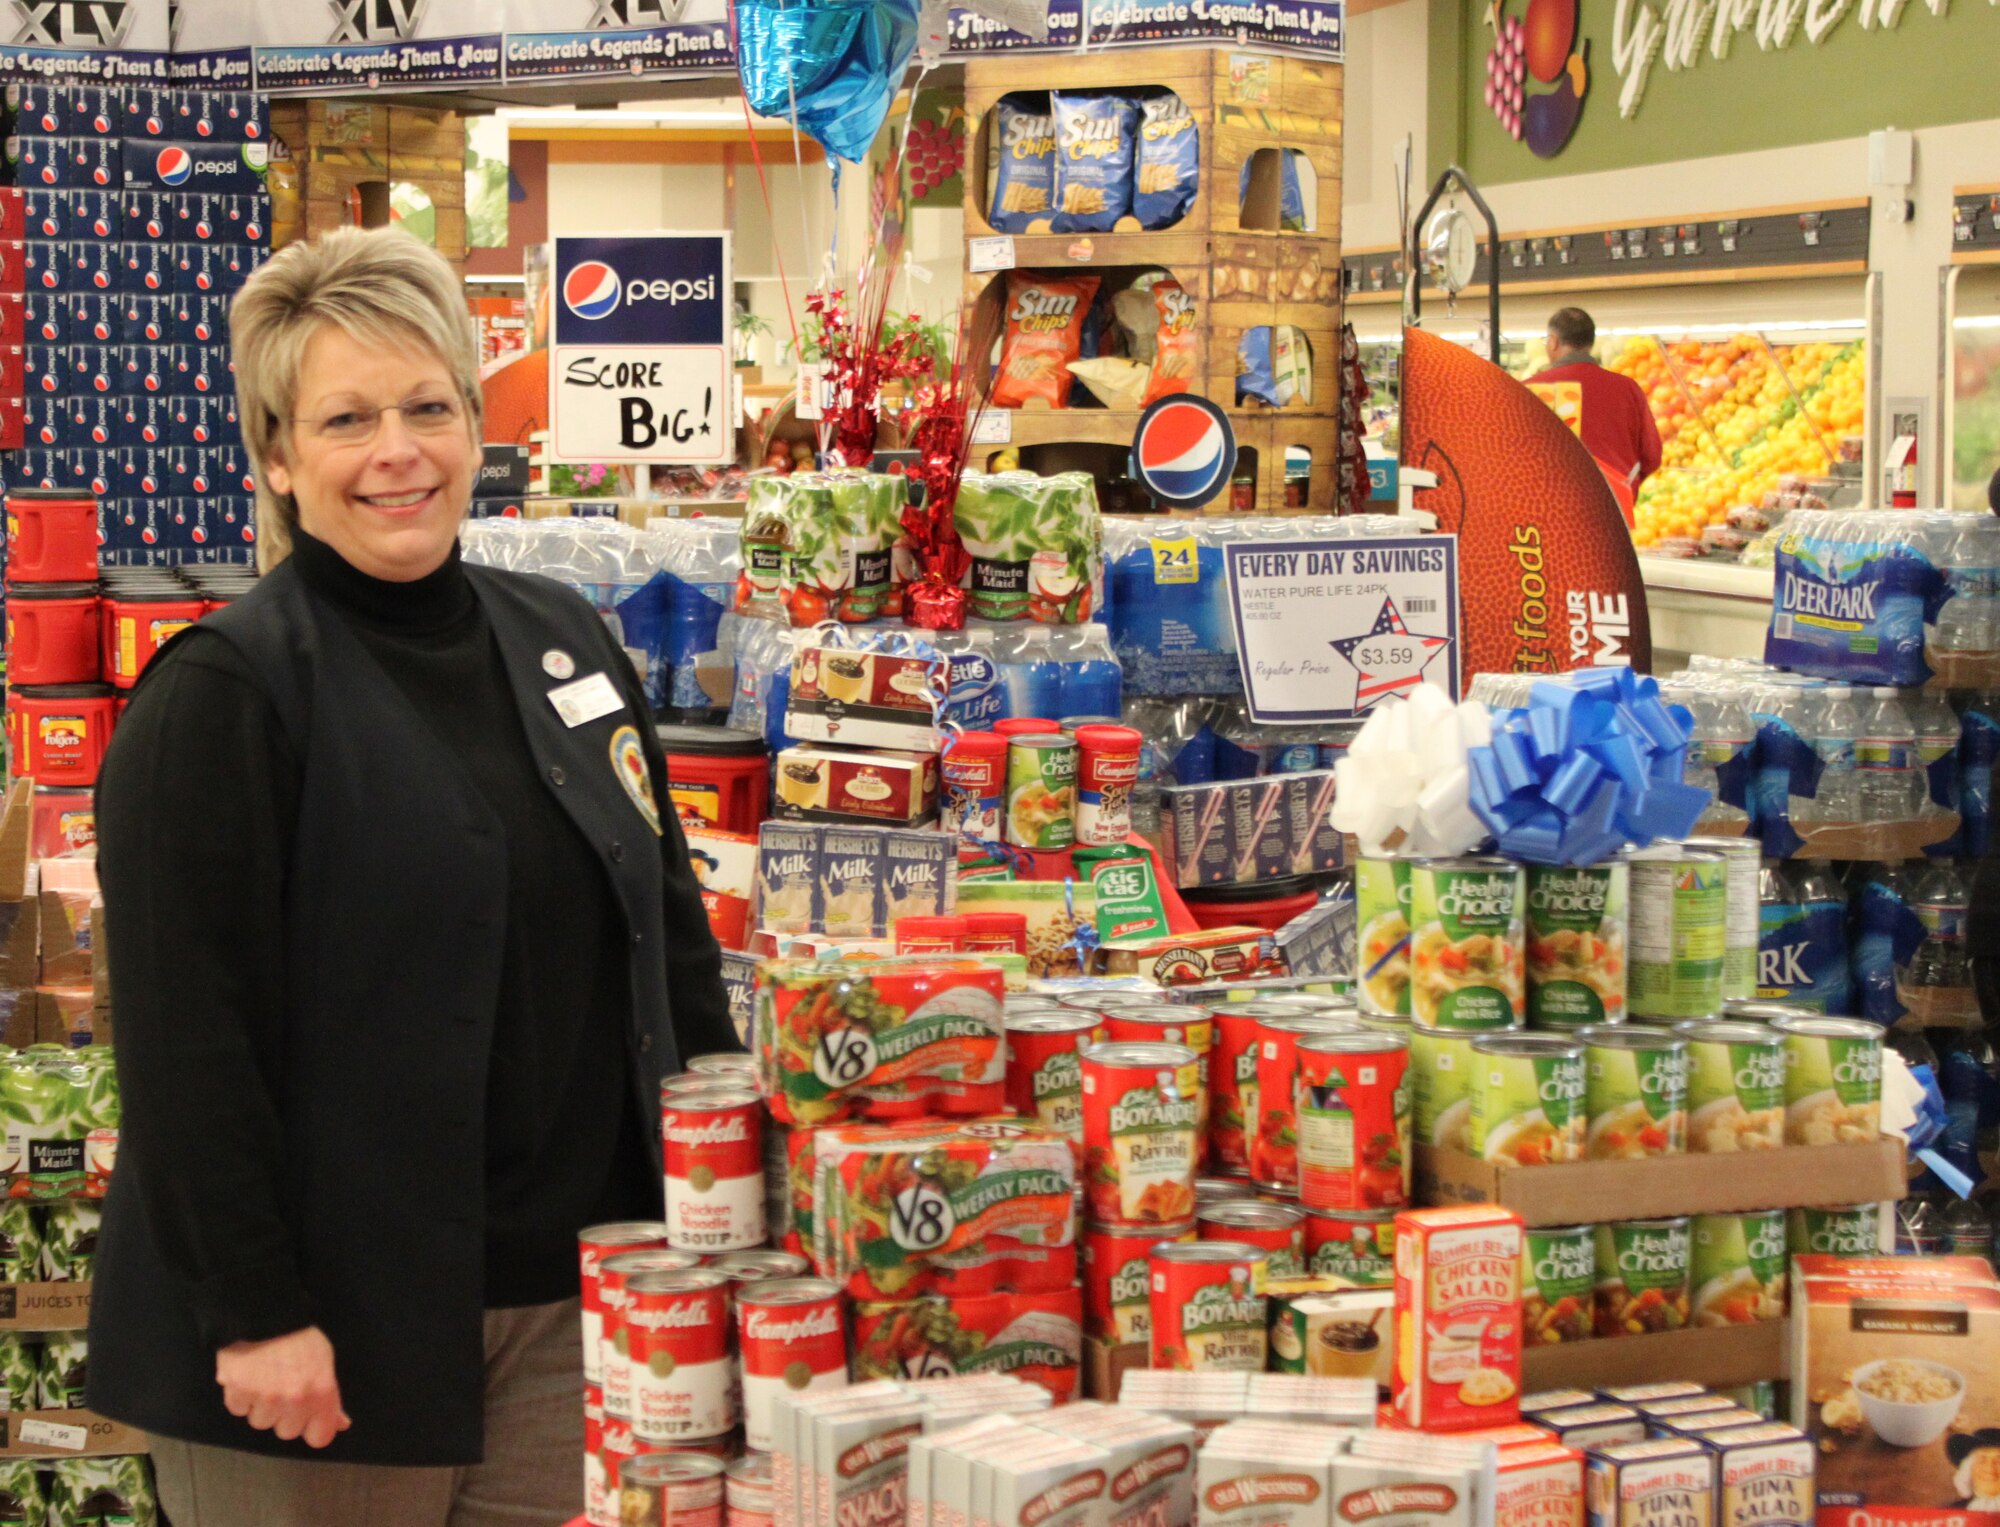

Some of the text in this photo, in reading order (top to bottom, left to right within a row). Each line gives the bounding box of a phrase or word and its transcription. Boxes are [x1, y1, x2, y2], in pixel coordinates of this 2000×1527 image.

[1047, 11, 1078, 29] ow
[1090, 4, 1187, 26] Celebrate
[1265, 6, 1297, 33] Then
[1299, 13, 1310, 27] &
[257, 36, 497, 74] Celebrate Legends Then & Now
[508, 31, 727, 62] Celebrate Legends Then &
[17, 53, 166, 78] Legends Then &
[199, 58, 210, 75] &
[212, 58, 249, 80] Now
[1061, 113, 1121, 145] Sun
[194, 158, 237, 176] pepsi
[626, 274, 714, 306] pepsi
[1012, 289, 1077, 320] Sun
[1020, 314, 1070, 334] Chips
[565, 357, 663, 389] SCORE
[618, 386, 712, 450] BIG!
[481, 464, 511, 479] pepsi
[859, 558, 888, 571] Minute
[1159, 548, 1190, 566] 24
[1239, 548, 1443, 577] EVERY DAY SAVINGS
[863, 568, 884, 582] Maid
[977, 563, 1025, 578] Minute
[983, 575, 1016, 588] Maid
[1243, 584, 1388, 599] WATER PURE LIFE 24PK
[1508, 525, 1547, 639] foods
[1783, 571, 1879, 619] DEER PARK
[1566, 590, 1589, 661] YOUR
[1361, 648, 1413, 665] $3.59
[1255, 660, 1330, 680] Regular Price
[964, 695, 1000, 720] Life
[45, 732, 80, 747] Folgers
[762, 832, 817, 851] HERSHEY'S
[824, 835, 879, 857] HERSHEY'S
[887, 840, 943, 861] HERSHEY'S
[767, 854, 812, 880] Milk
[828, 859, 875, 883] Milk
[891, 864, 938, 887] Milk
[1107, 869, 1139, 886] tic
[1102, 881, 1141, 896] tac
[1449, 876, 1517, 899] Healthy
[1540, 871, 1609, 896] Healthy
[1437, 894, 1513, 915] Choice
[1529, 890, 1605, 912] Choice
[1128, 921, 1149, 931] pack
[727, 985, 753, 1004] ilk
[1456, 996, 1498, 1008] Chicken
[1543, 990, 1585, 1002] Chicken
[1453, 1008, 1502, 1019] with Rice
[1541, 1003, 1589, 1014] with Rice
[880, 1021, 986, 1060] WEEKLY PACK
[820, 1026, 867, 1081] V8
[663, 1115, 746, 1149] Campbell's
[33, 1145, 80, 1158] Minute
[40, 1155, 73, 1169] Maid
[1130, 1141, 1187, 1162] Ravioli
[954, 1174, 1062, 1220] WEEKLY PACK
[679, 1202, 731, 1216] Chicken
[893, 1182, 943, 1245] V8
[681, 1215, 731, 1229] Noodle
[680, 1232, 731, 1246] SOUP
[1430, 1240, 1504, 1265] BUMBLE BEE
[1436, 1260, 1512, 1285] CHICKEN
[1439, 1280, 1508, 1301] SALAD
[22, 1295, 72, 1308] JUICES
[625, 1296, 710, 1333] Campbell's
[746, 1306, 838, 1345] Campbell's
[1023, 1348, 1065, 1367] PACK
[1204, 1338, 1261, 1361] Ravioli
[639, 1387, 692, 1402] Chicken
[641, 1403, 691, 1417] Noodle
[92, 1422, 112, 1434] GO
[641, 1419, 692, 1433] SOUP
[1725, 1458, 1797, 1483] BUMBLE BEE
[1543, 1479, 1565, 1492] BEE
[1624, 1473, 1694, 1499] BUMBLE BEE
[1740, 1479, 1794, 1500] TUNA
[1213, 1489, 1237, 1505] OLD
[1350, 1499, 1371, 1516] OLD
[1638, 1494, 1692, 1517] TUNA
[1501, 1499, 1574, 1525] CHICKEN
[1735, 1499, 1800, 1521] SALAD
